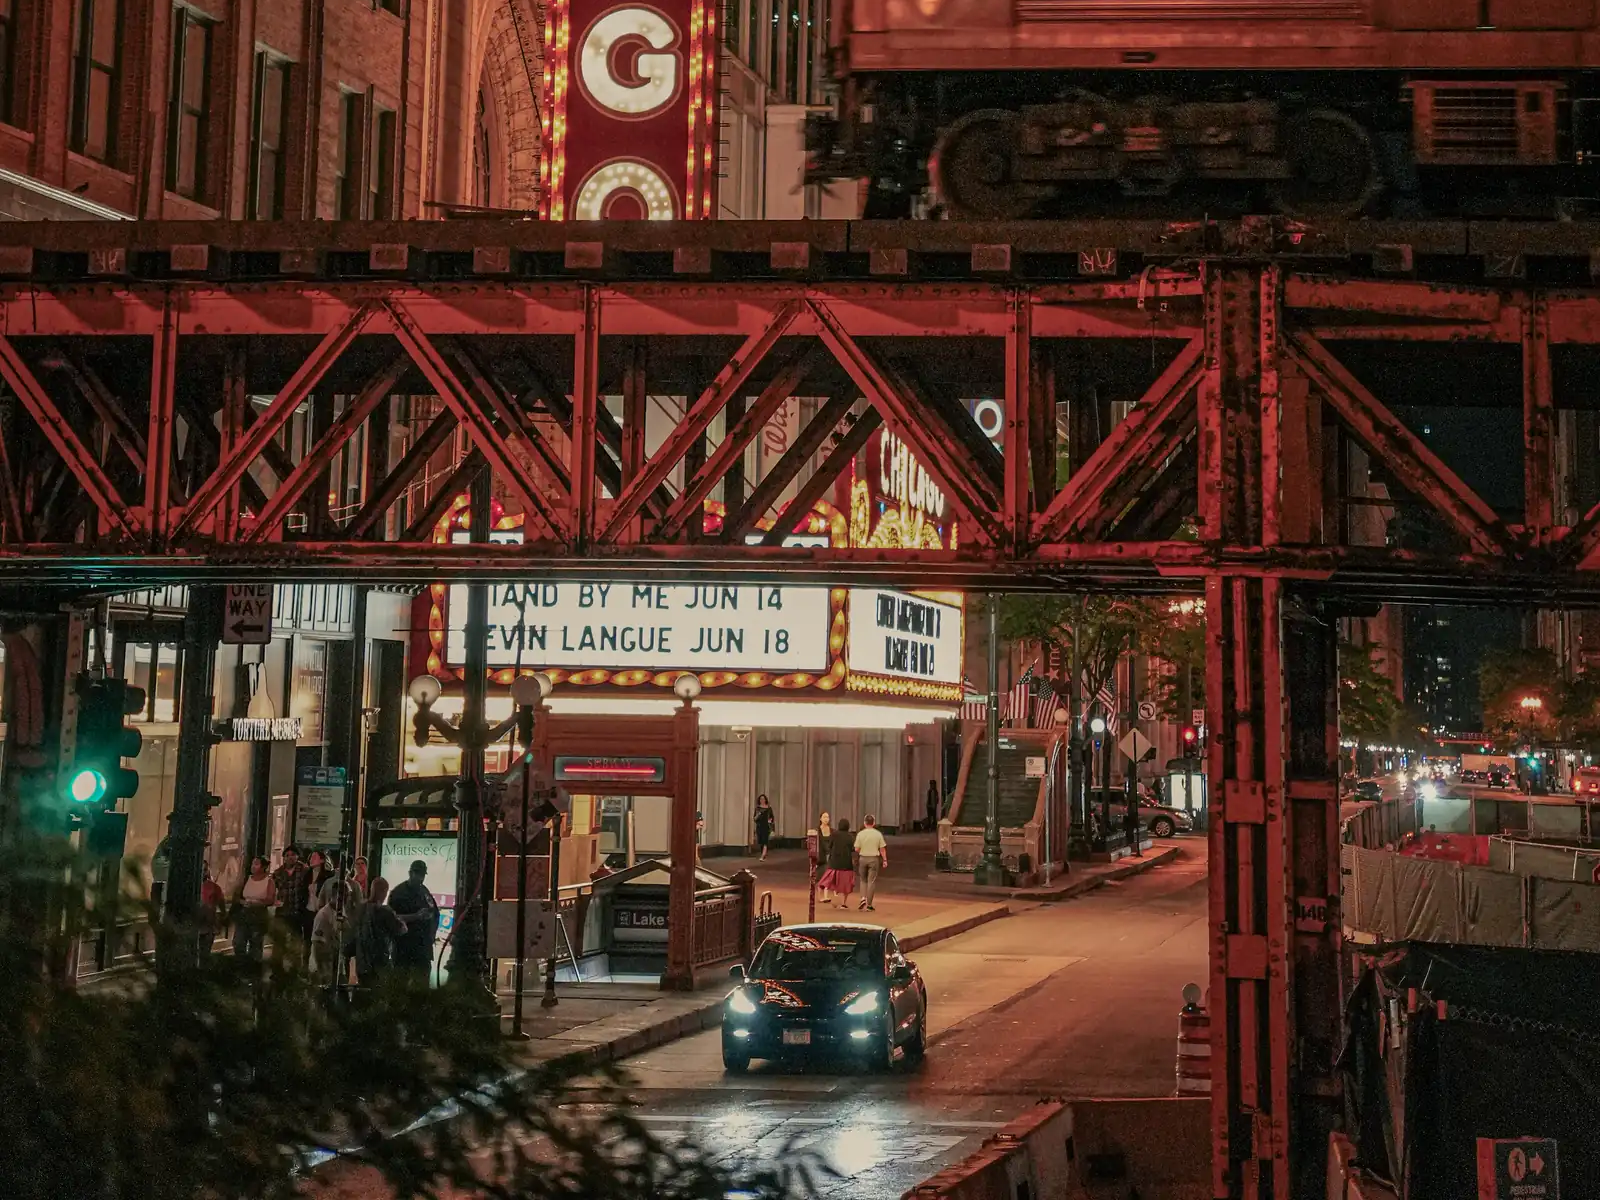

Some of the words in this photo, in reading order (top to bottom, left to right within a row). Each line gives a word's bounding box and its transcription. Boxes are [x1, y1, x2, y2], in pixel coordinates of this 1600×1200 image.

[231, 584, 267, 597] ONE
[578, 585, 612, 608] BY
[685, 587, 738, 610] JUN
[758, 588, 783, 610] 14
[229, 600, 266, 617] WAY
[486, 624, 547, 651] EVIN
[562, 625, 673, 653] LANGUE
[689, 627, 744, 653] JUN
[764, 629, 789, 654] 18
[232, 717, 270, 741] TORTURE
[384, 843, 438, 856] Matisse's
[633, 912, 665, 926] Lake
